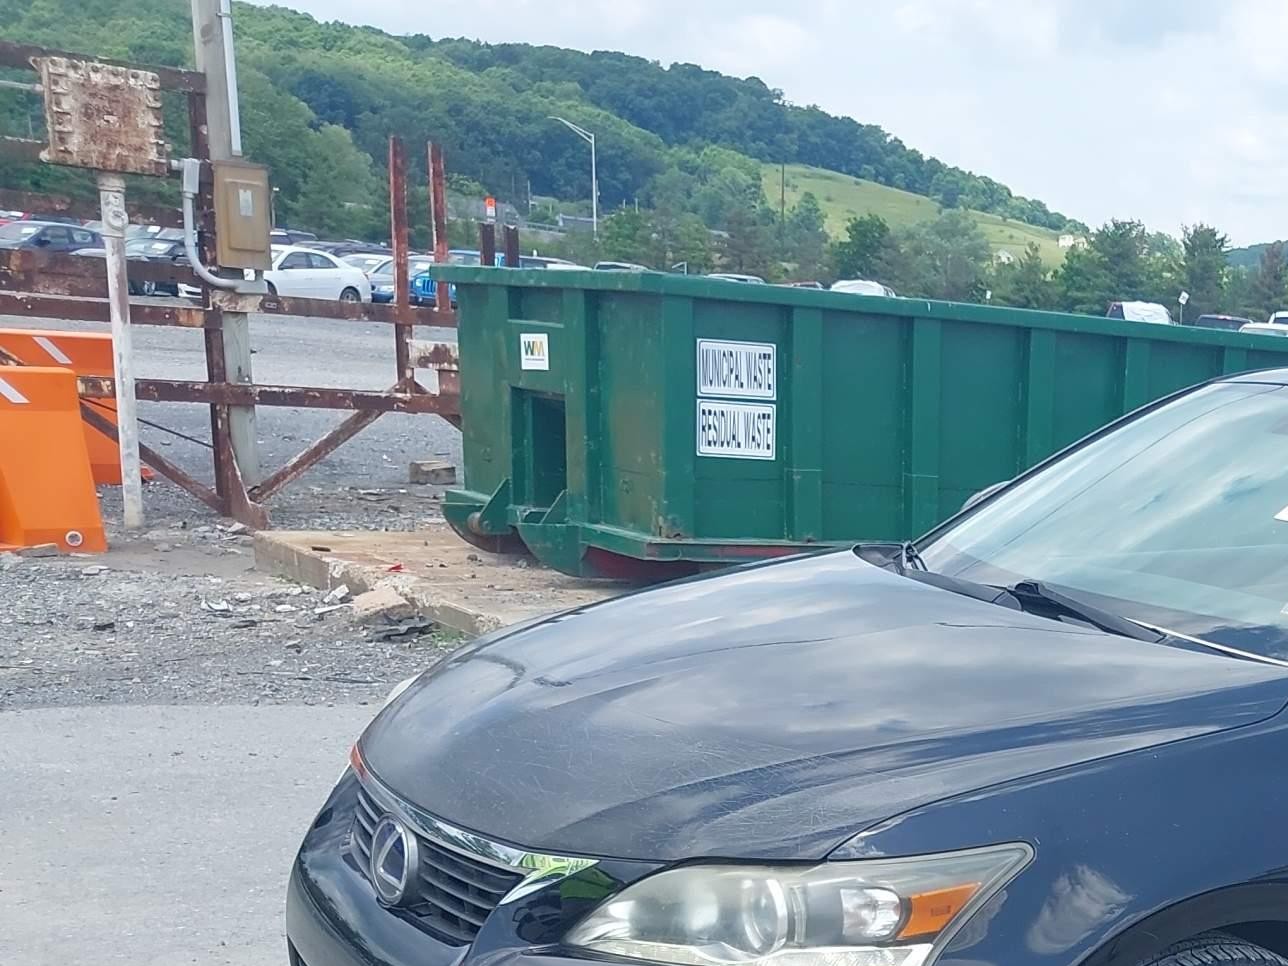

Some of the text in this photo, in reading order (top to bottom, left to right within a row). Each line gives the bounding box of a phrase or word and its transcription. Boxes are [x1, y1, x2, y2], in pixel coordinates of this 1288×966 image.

[524, 340, 545, 357] WM
[701, 348, 772, 391] MUNICIPAL WASTE
[701, 408, 771, 451] RESIDUAL WASTE
